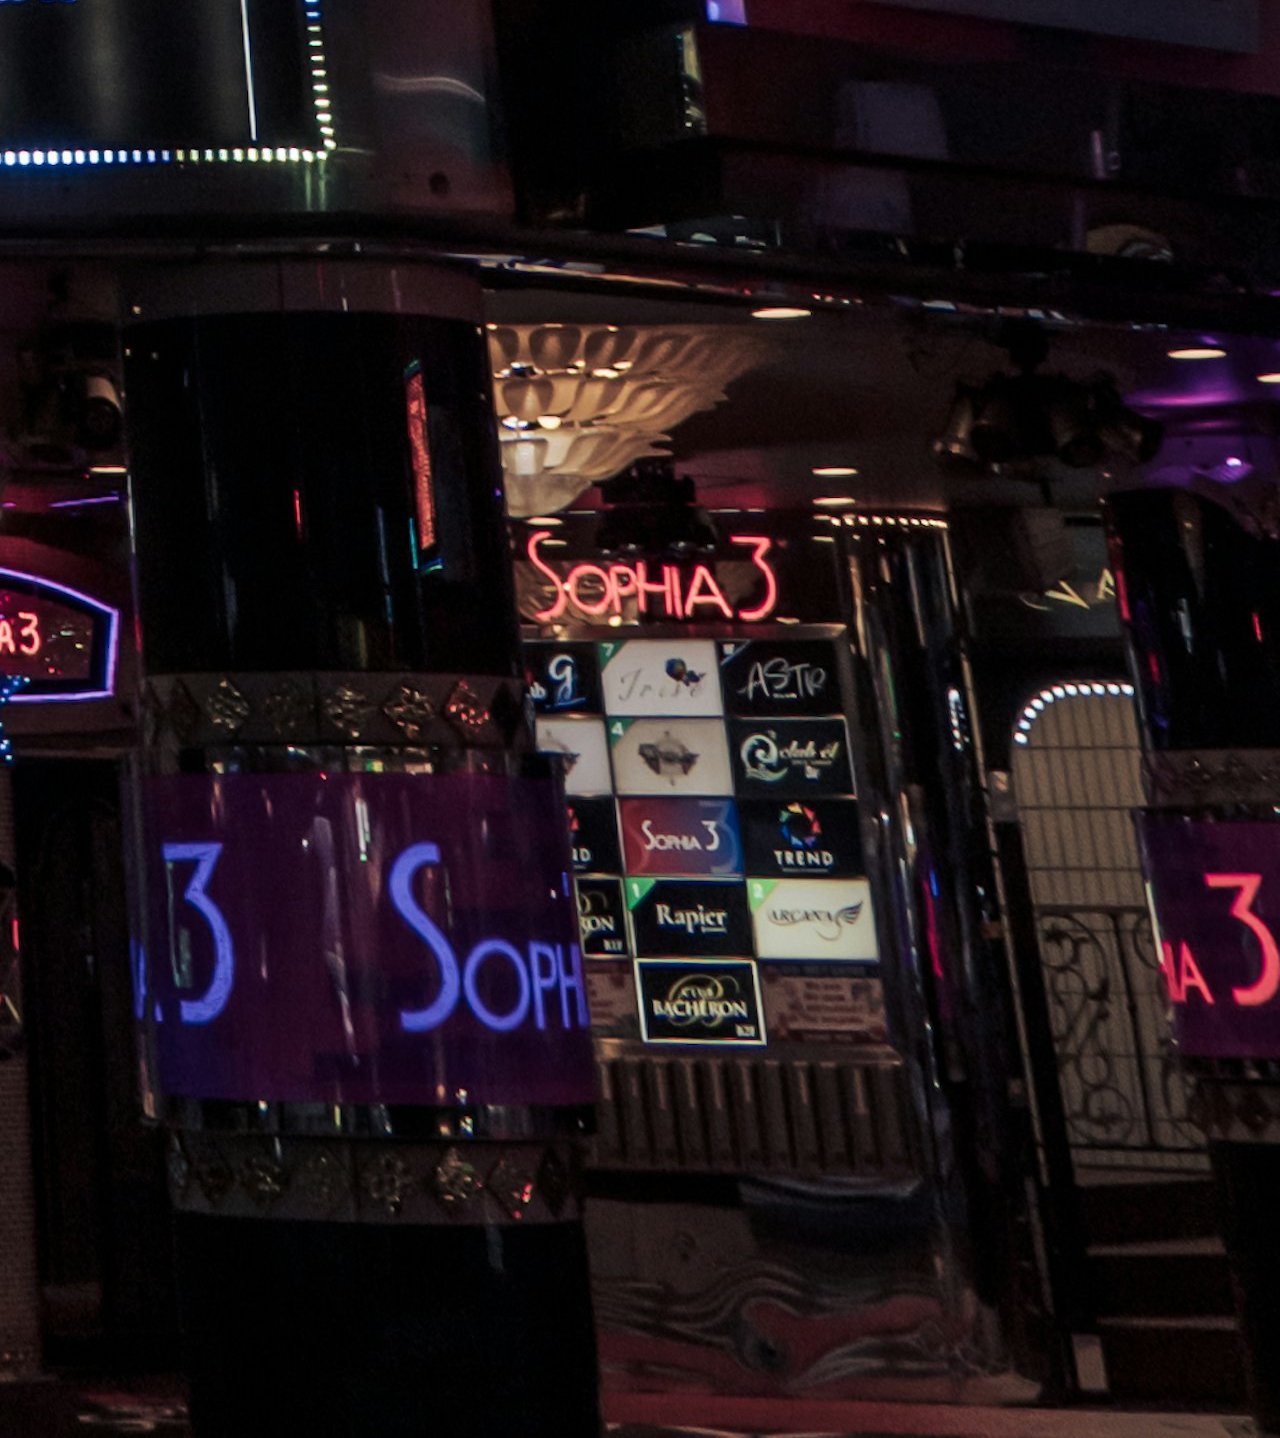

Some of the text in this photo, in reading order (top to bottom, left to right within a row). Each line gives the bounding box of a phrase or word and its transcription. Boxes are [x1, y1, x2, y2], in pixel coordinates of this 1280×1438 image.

[526, 529, 778, 622] SOPHIA 3
[16, 610, 42, 657] 3
[773, 849, 835, 868] TREND
[160, 841, 237, 1026] 3
[654, 901, 730, 937] Rapier
[1203, 870, 1280, 1008] 3
[651, 997, 749, 1022] BACHERON
